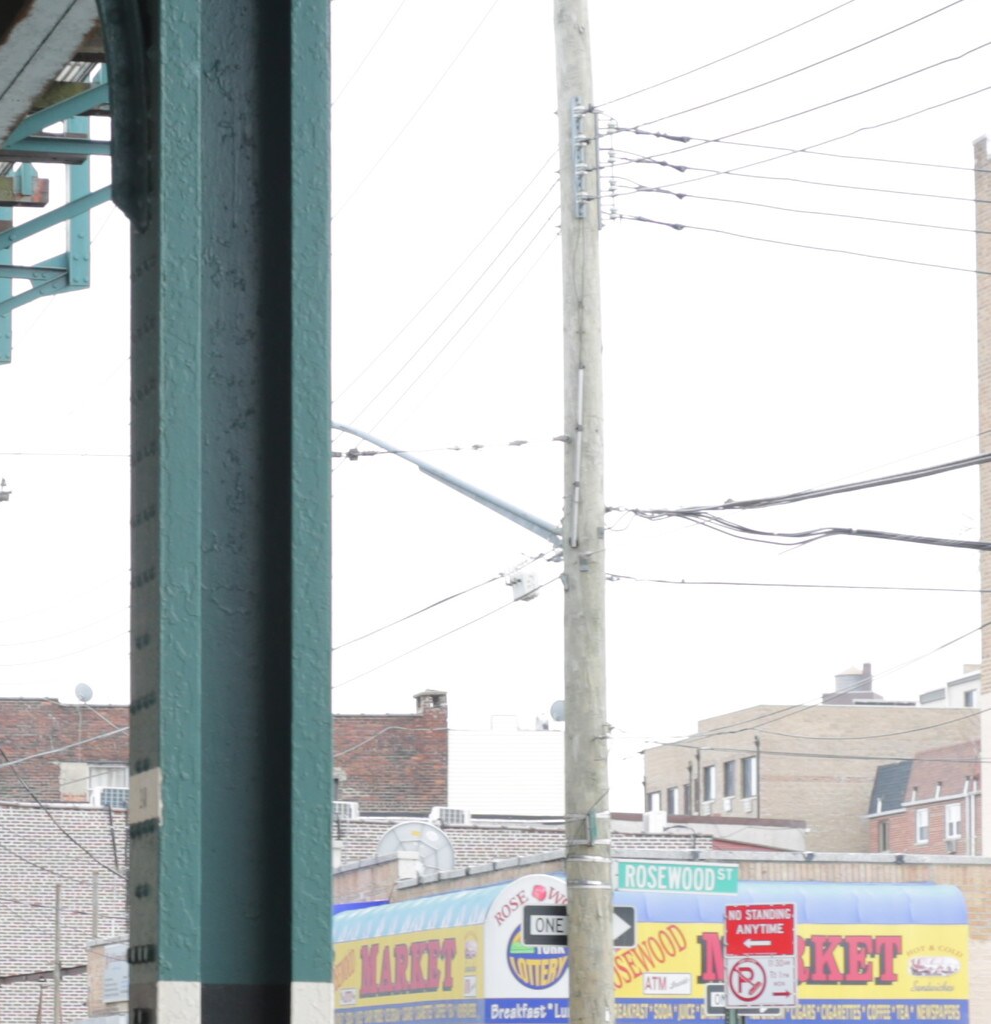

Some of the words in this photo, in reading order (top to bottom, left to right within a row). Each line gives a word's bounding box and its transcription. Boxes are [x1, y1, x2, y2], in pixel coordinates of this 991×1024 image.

[625, 864, 716, 891] ROSEWOOD
[717, 868, 734, 881] ST
[494, 890, 529, 926] ROSE
[728, 910, 742, 920] NO
[745, 908, 791, 920] STANDING
[535, 917, 564, 933] ONE
[736, 923, 785, 935] ANYTIME
[614, 925, 687, 989] OSEWOOD
[698, 931, 903, 985] MKET
[360, 938, 457, 999] MARKET
[510, 956, 569, 986] LOTTERY
[645, 976, 668, 990] ATM
[490, 1003, 547, 1019] Breakfast
[654, 1004, 674, 1019] SODA
[677, 1004, 696, 1020] JUICE
[791, 1004, 817, 1020] CIGARS
[821, 1004, 861, 1020] CIGARETTES
[867, 1004, 891, 1020] COFFEE
[896, 1004, 910, 1020] TEA
[916, 1004, 960, 1020] NEWSPAPERS
